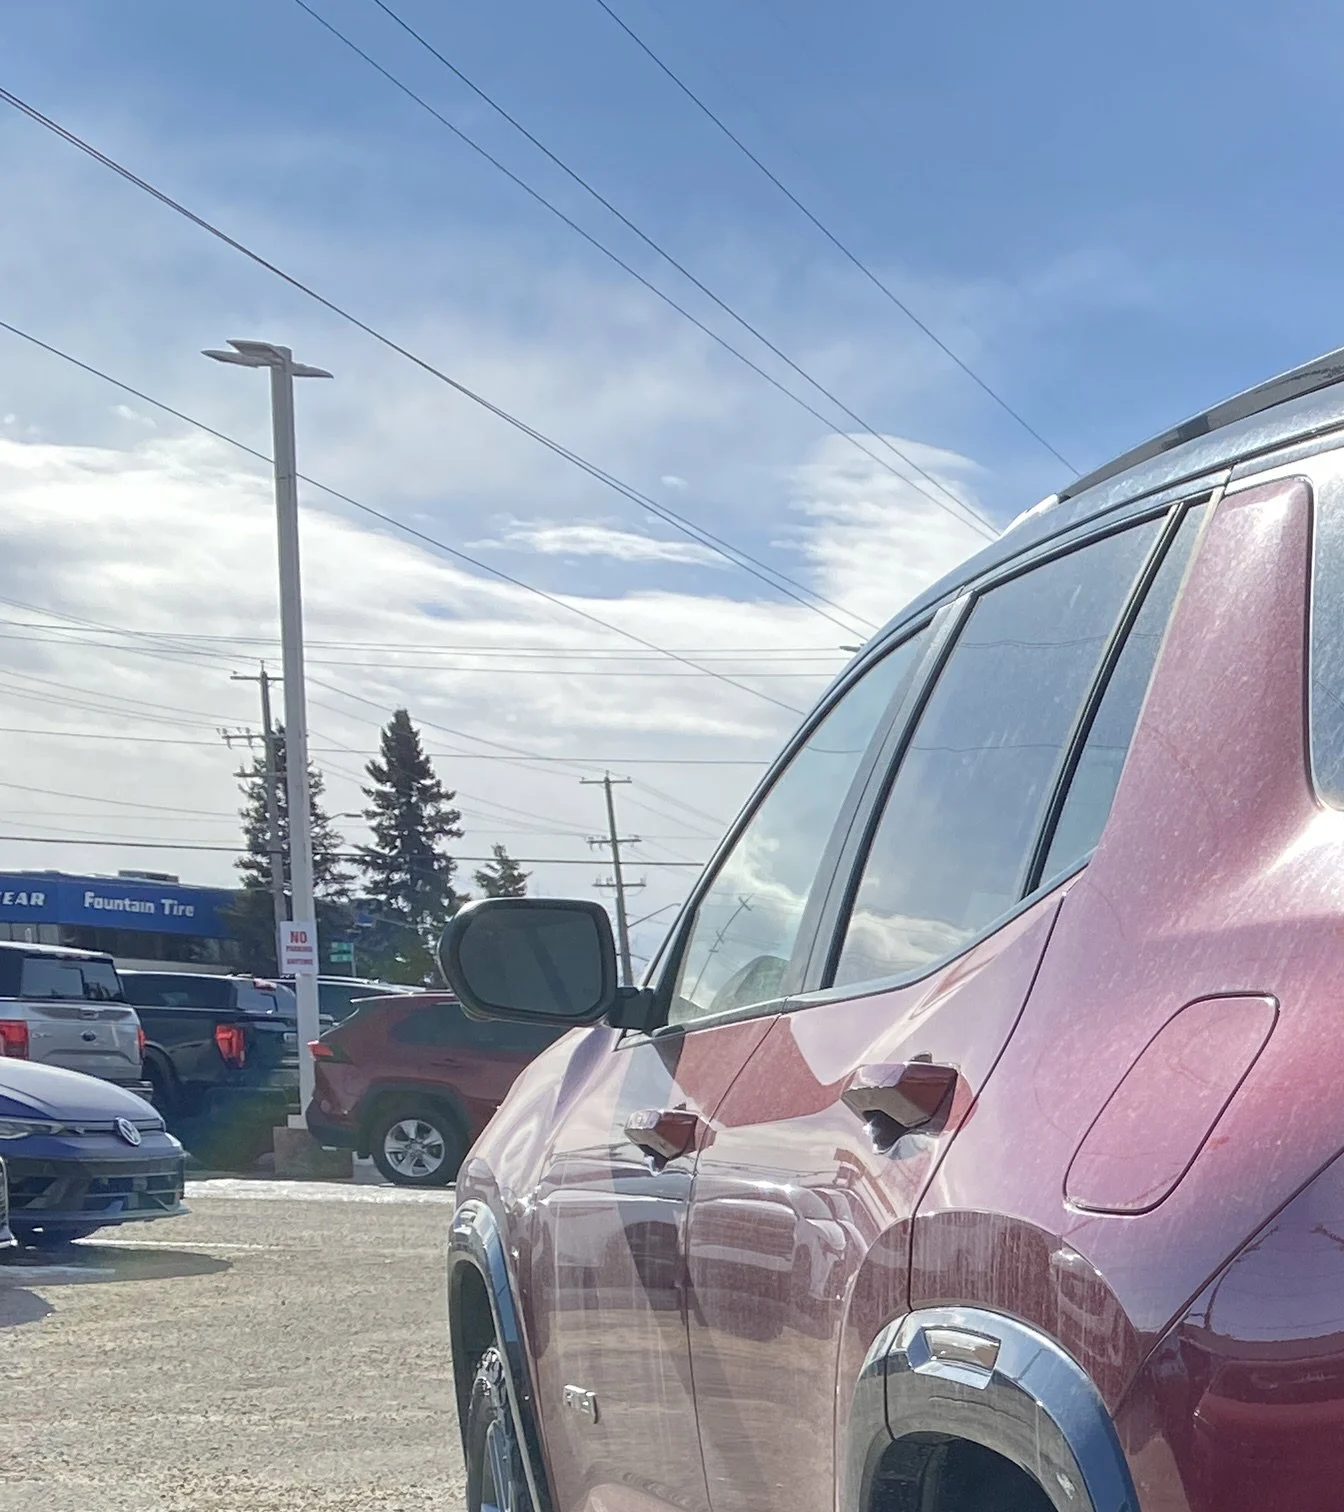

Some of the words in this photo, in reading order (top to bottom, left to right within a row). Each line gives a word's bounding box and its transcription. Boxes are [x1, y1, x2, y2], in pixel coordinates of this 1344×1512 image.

[0, 891, 46, 906] EAR
[83, 890, 155, 915] Fountain
[160, 898, 195, 918] Tire
[290, 930, 308, 944] NO
